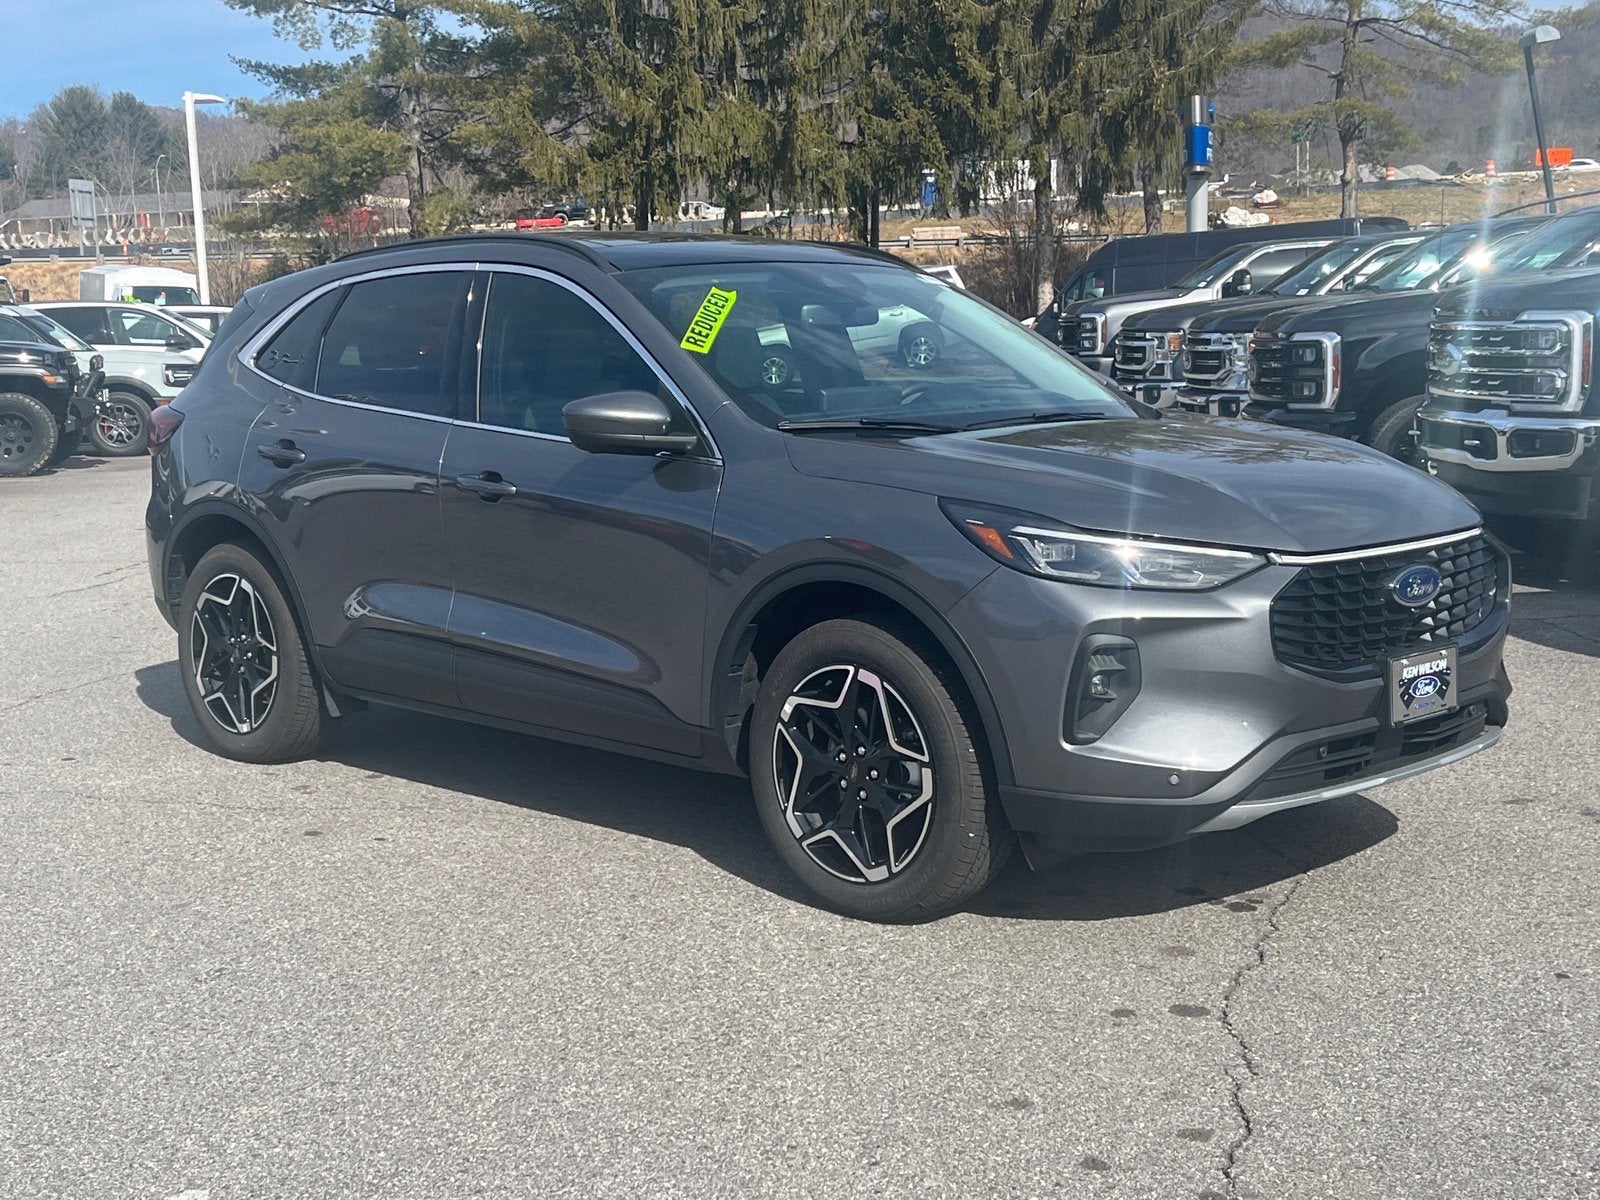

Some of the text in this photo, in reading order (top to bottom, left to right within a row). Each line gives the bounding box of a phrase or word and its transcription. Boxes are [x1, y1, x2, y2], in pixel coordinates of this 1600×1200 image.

[685, 292, 730, 349] REDUCED
[1407, 575, 1434, 598] Ford
[1402, 658, 1448, 680] KEN WILSON
[1415, 679, 1435, 696] Ford
